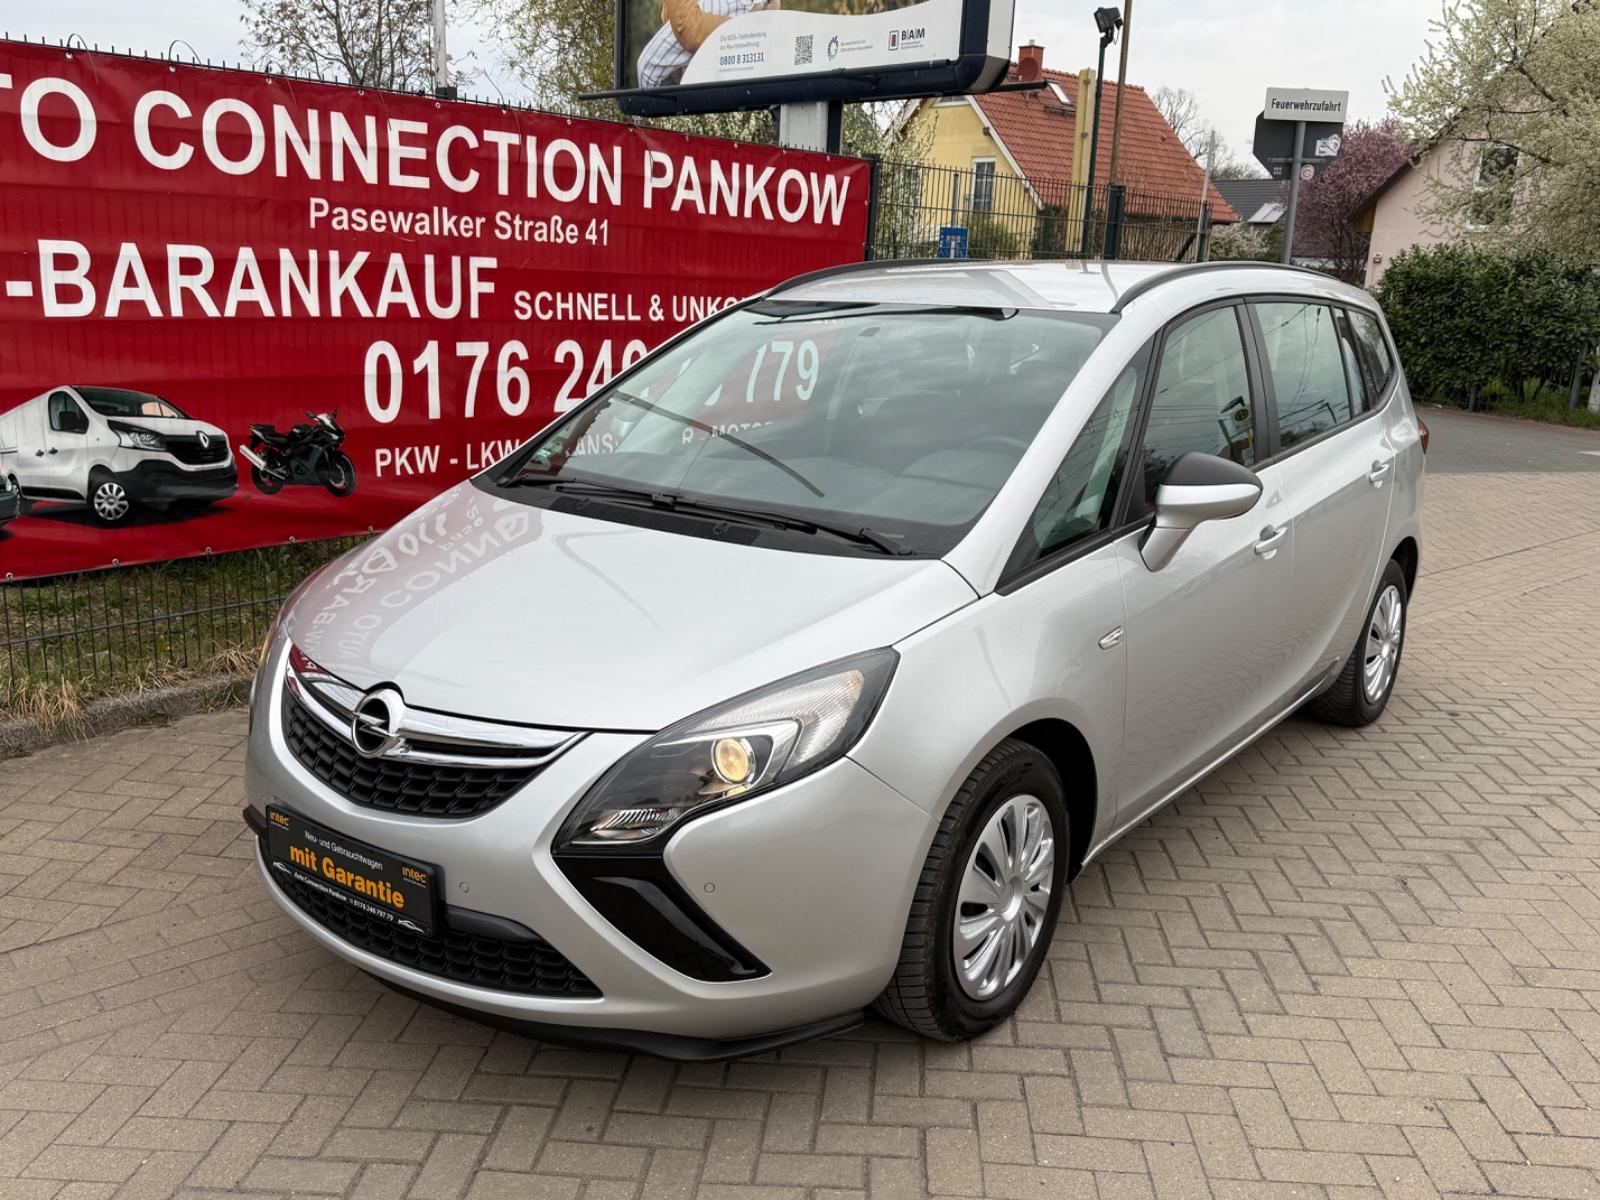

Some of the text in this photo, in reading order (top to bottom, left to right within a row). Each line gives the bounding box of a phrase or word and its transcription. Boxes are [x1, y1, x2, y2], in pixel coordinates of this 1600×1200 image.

[720, 52, 764, 66] 0800 8 313131
[1271, 98, 1341, 112] Feuerwehrzufahrt
[0, 73, 850, 226] O CONNECTION PANKOW
[309, 197, 609, 247] Pasewalker Straße 41
[514, 290, 641, 321] SCHNELL
[648, 294, 665, 321] &
[363, 340, 531, 424] 0176
[374, 445, 441, 478] PKW
[270, 811, 289, 826] intec
[319, 838, 331, 850] und
[331, 843, 384, 870] Gebrauchtwagen
[290, 845, 405, 909] mit Garantie
[402, 866, 427, 884] intec
